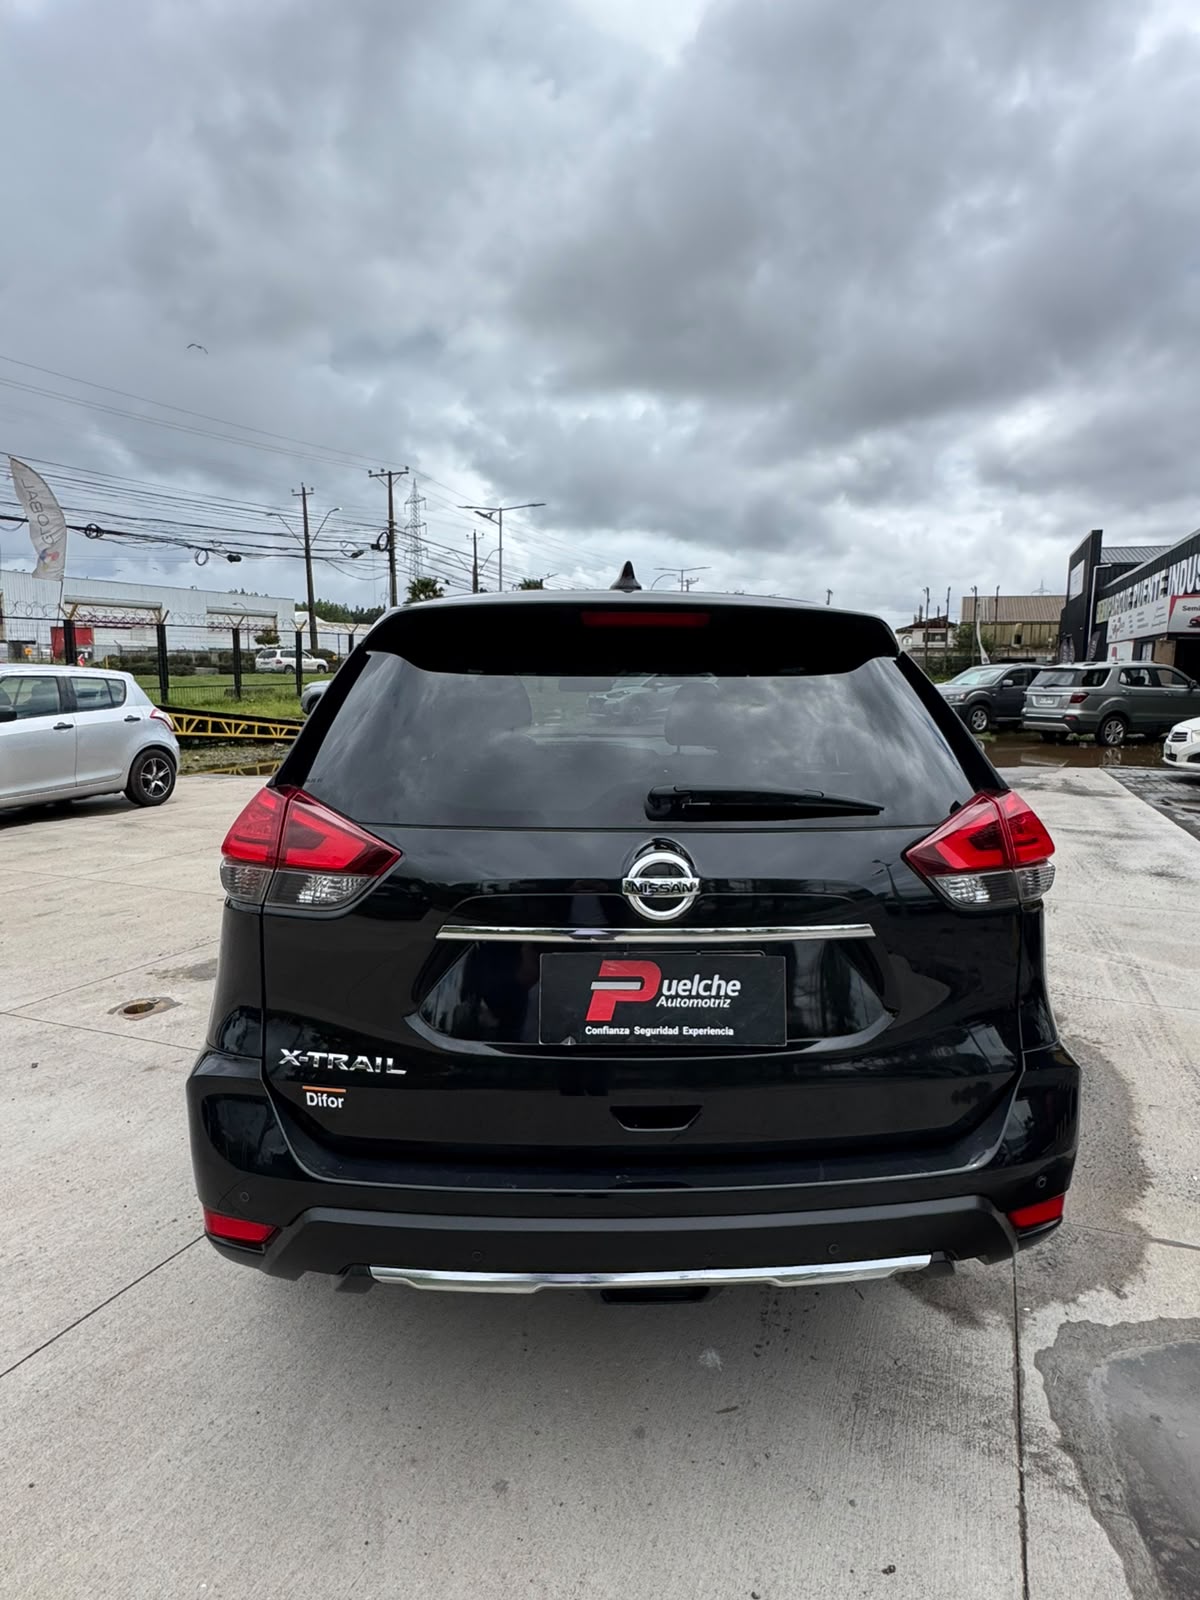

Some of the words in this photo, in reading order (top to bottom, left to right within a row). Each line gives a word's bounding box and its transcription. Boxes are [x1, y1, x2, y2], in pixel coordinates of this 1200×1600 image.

[630, 881, 694, 894] NISSAN
[585, 959, 742, 1023] Puelche
[656, 995, 732, 1010] Automotriz
[585, 1025, 630, 1036] Confianza
[633, 1025, 679, 1037] Seguridad
[682, 1026, 734, 1037] Experiencia
[278, 1048, 408, 1075] X-TRAIL
[305, 1091, 345, 1109] Difor
